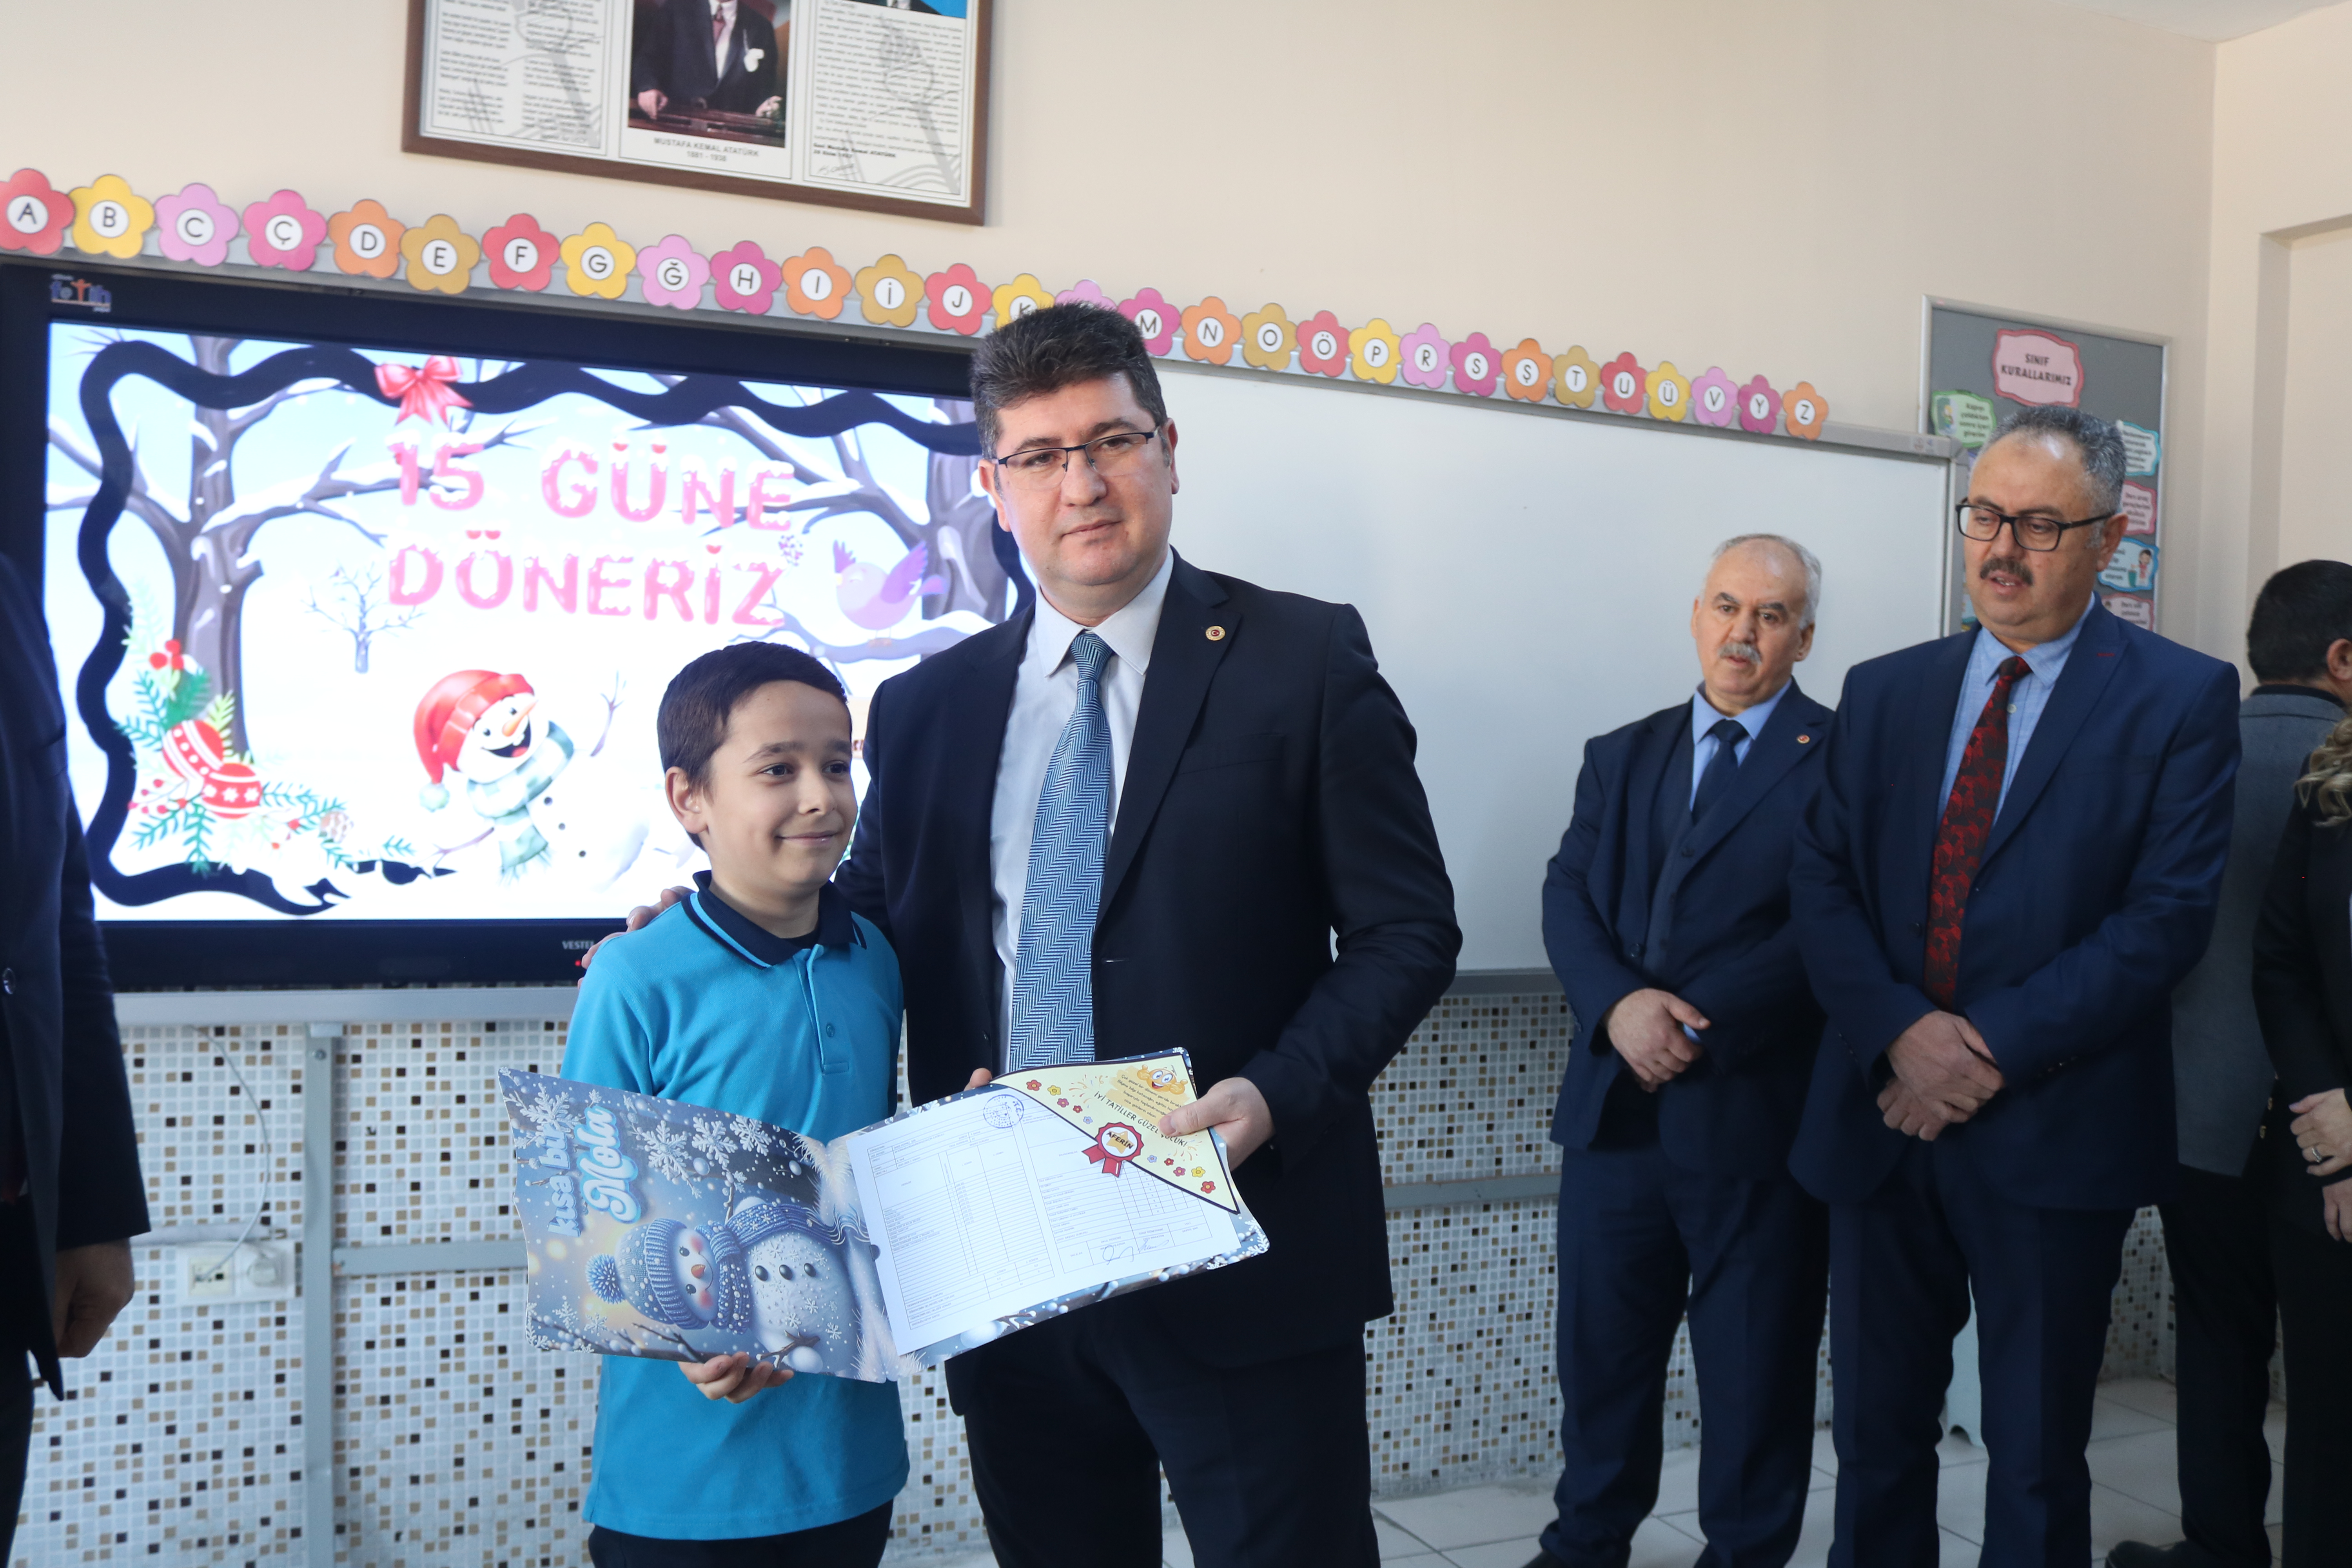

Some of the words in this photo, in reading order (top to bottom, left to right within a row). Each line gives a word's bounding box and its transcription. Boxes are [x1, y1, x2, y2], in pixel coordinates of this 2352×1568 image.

[654, 138, 691, 147] MUSTAFA
[693, 142, 721, 152] KEMAL
[18, 203, 36, 224] A
[103, 207, 116, 227] B
[185, 217, 204, 238] C
[273, 221, 292, 244] Ç
[361, 231, 377, 250] D
[434, 247, 446, 267] E
[516, 246, 527, 264] F
[589, 254, 607, 273] G
[664, 262, 682, 285] Ğ
[738, 269, 754, 289] H
[888, 282, 891, 305] İ
[952, 292, 963, 308] J
[1140, 315, 1156, 334] M
[1203, 323, 1218, 341] N
[1317, 334, 1330, 355] Ö
[1372, 346, 1381, 361] P
[1422, 350, 1430, 366] R
[1472, 358, 1480, 374] S
[1523, 365, 1531, 383] Ş
[1572, 370, 1582, 386] T
[1620, 378, 1630, 395] U
[1662, 383, 1673, 403] Ü
[1709, 391, 1720, 407] V
[1755, 397, 1765, 414] Y
[1800, 405, 1809, 420] Z
[2001, 365, 2072, 386] KURALLARIMIZ
[2025, 353, 2050, 365] SINIF
[387, 432, 485, 511] 15
[541, 436, 795, 531] GÜNE
[388, 529, 785, 627] DÖNERİZ
[1094, 1091, 1106, 1102] İYİ
[1105, 1099, 1137, 1121] TATİLLER
[1138, 1119, 1159, 1134] GÜZEL
[538, 1123, 571, 1170] bir
[1106, 1131, 1134, 1149] AFERİN
[574, 1106, 641, 1224] Mola
